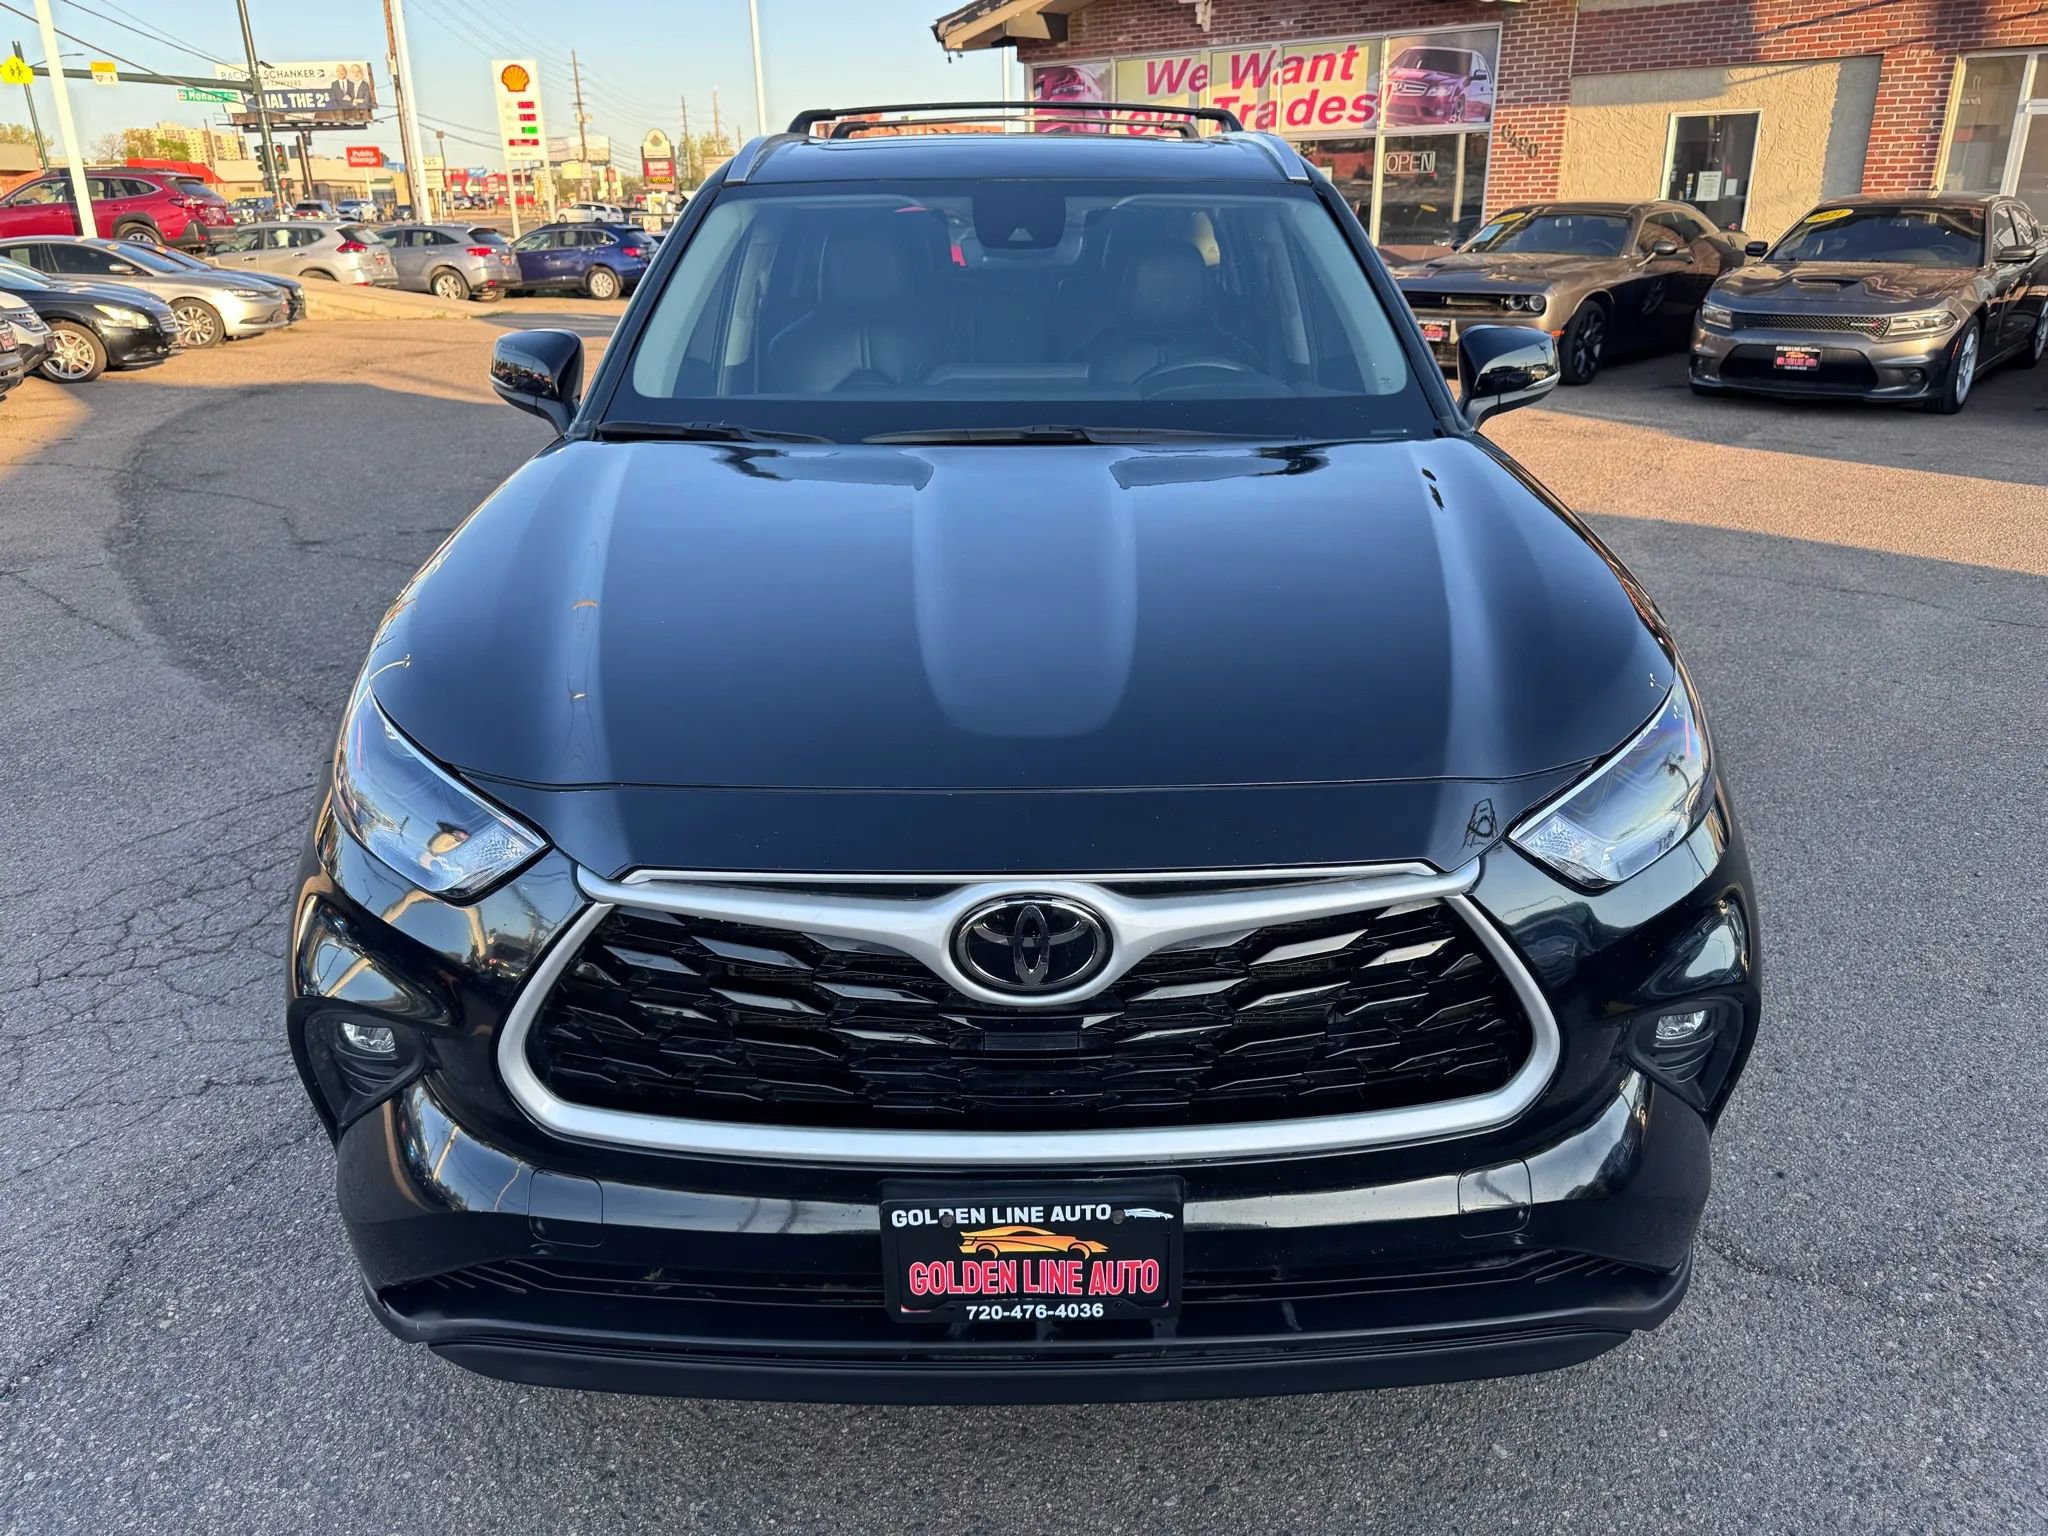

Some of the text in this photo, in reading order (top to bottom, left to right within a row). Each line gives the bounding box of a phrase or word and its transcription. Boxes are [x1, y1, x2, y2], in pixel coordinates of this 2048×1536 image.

[263, 69, 315, 80] SCHANKER
[1146, 44, 1360, 96] We Want
[288, 93, 315, 109] THE
[1386, 152, 1434, 173] OPEN
[992, 1206, 1044, 1224] LINE
[1050, 1204, 1111, 1222] AUTO
[909, 1258, 1160, 1296] GOLDEN LINE AUTO
[966, 1303, 1104, 1321] 720-476-4036
